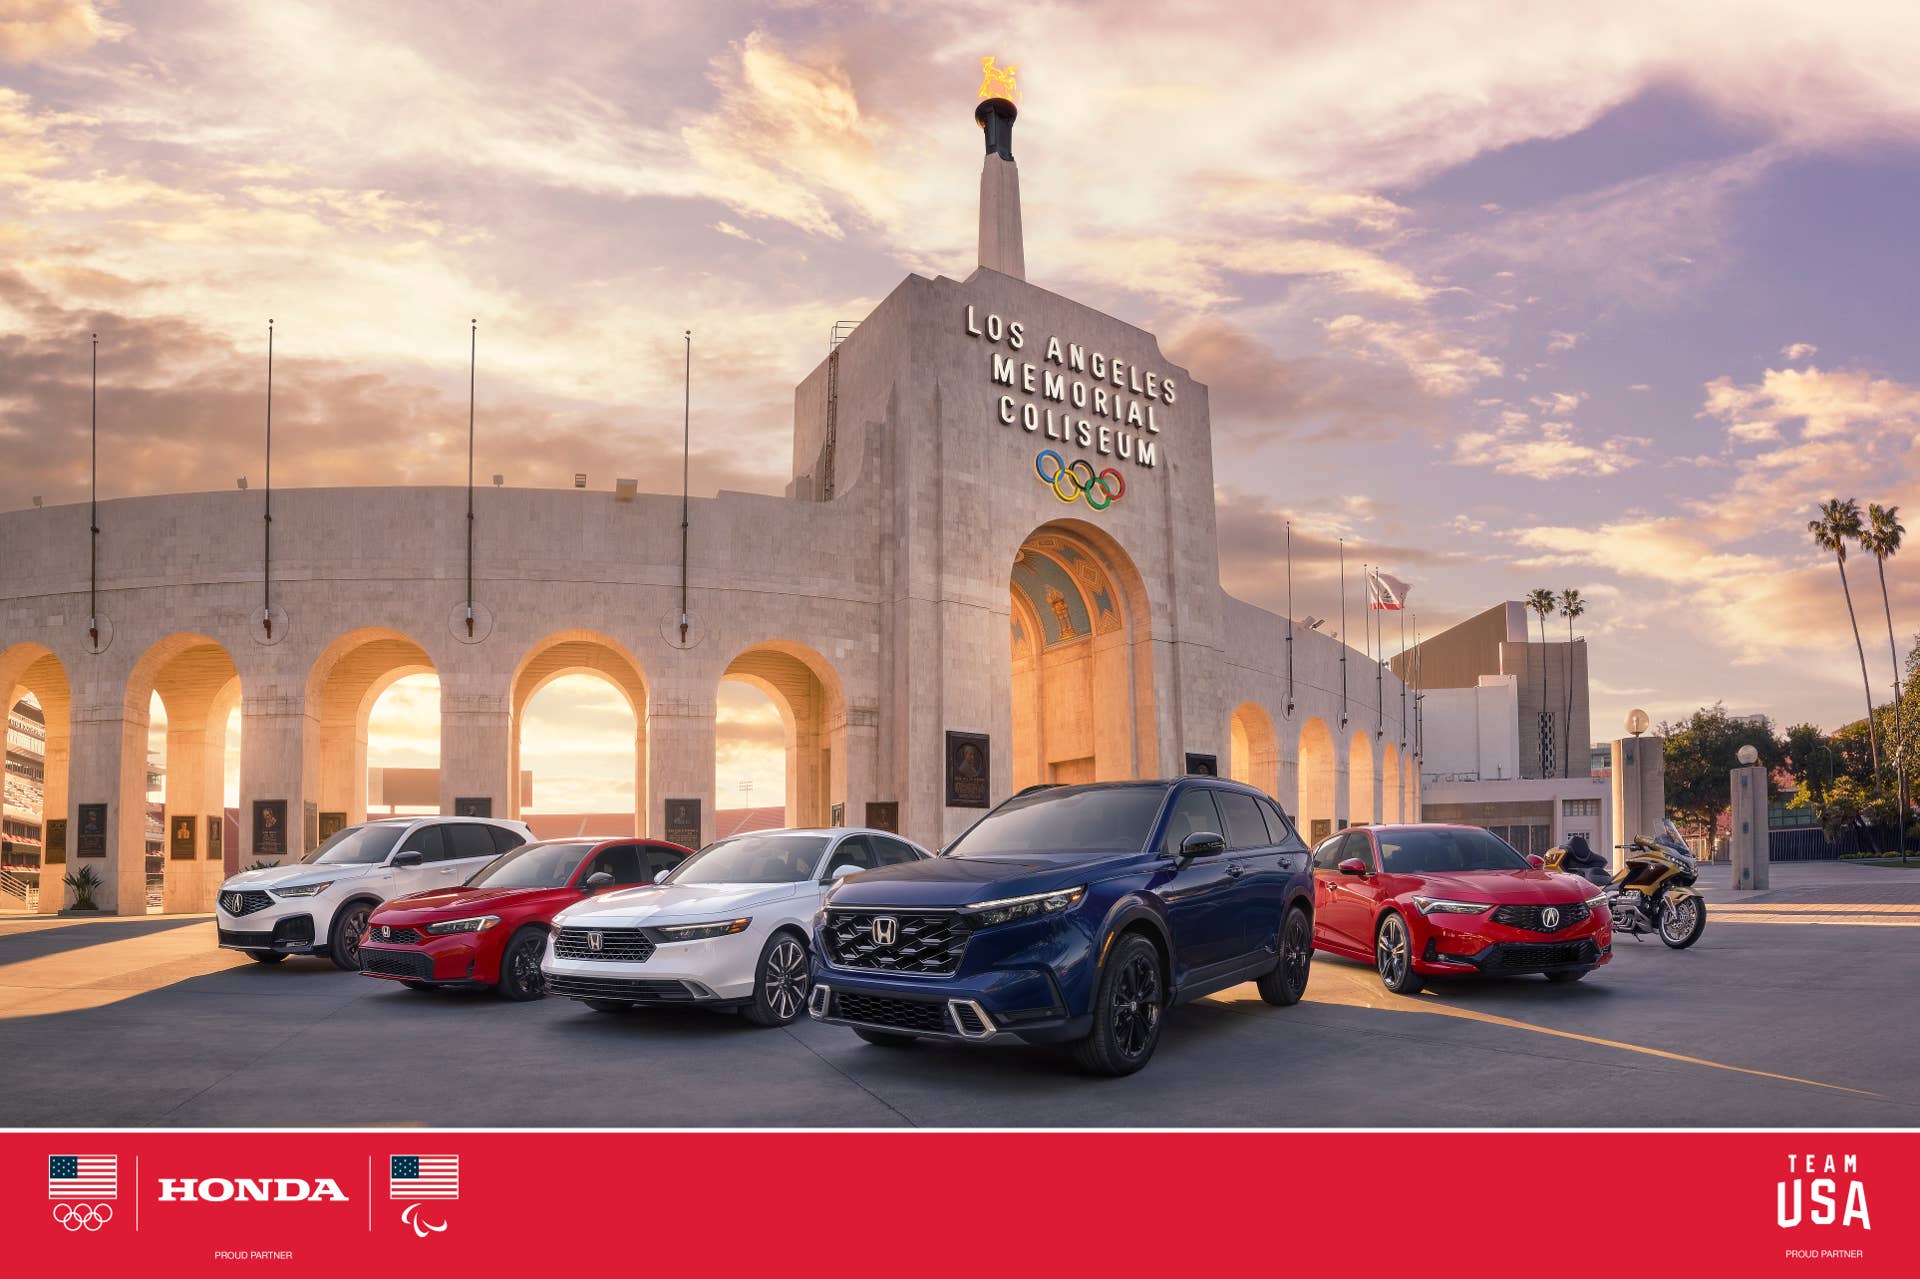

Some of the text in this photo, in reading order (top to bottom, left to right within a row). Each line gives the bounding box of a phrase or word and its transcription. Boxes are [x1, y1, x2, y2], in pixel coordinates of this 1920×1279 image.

[965, 305, 1176, 405] LOS ANGELES
[992, 353, 1159, 435] MEMORIAL
[1000, 395, 1156, 467] COLISEUM
